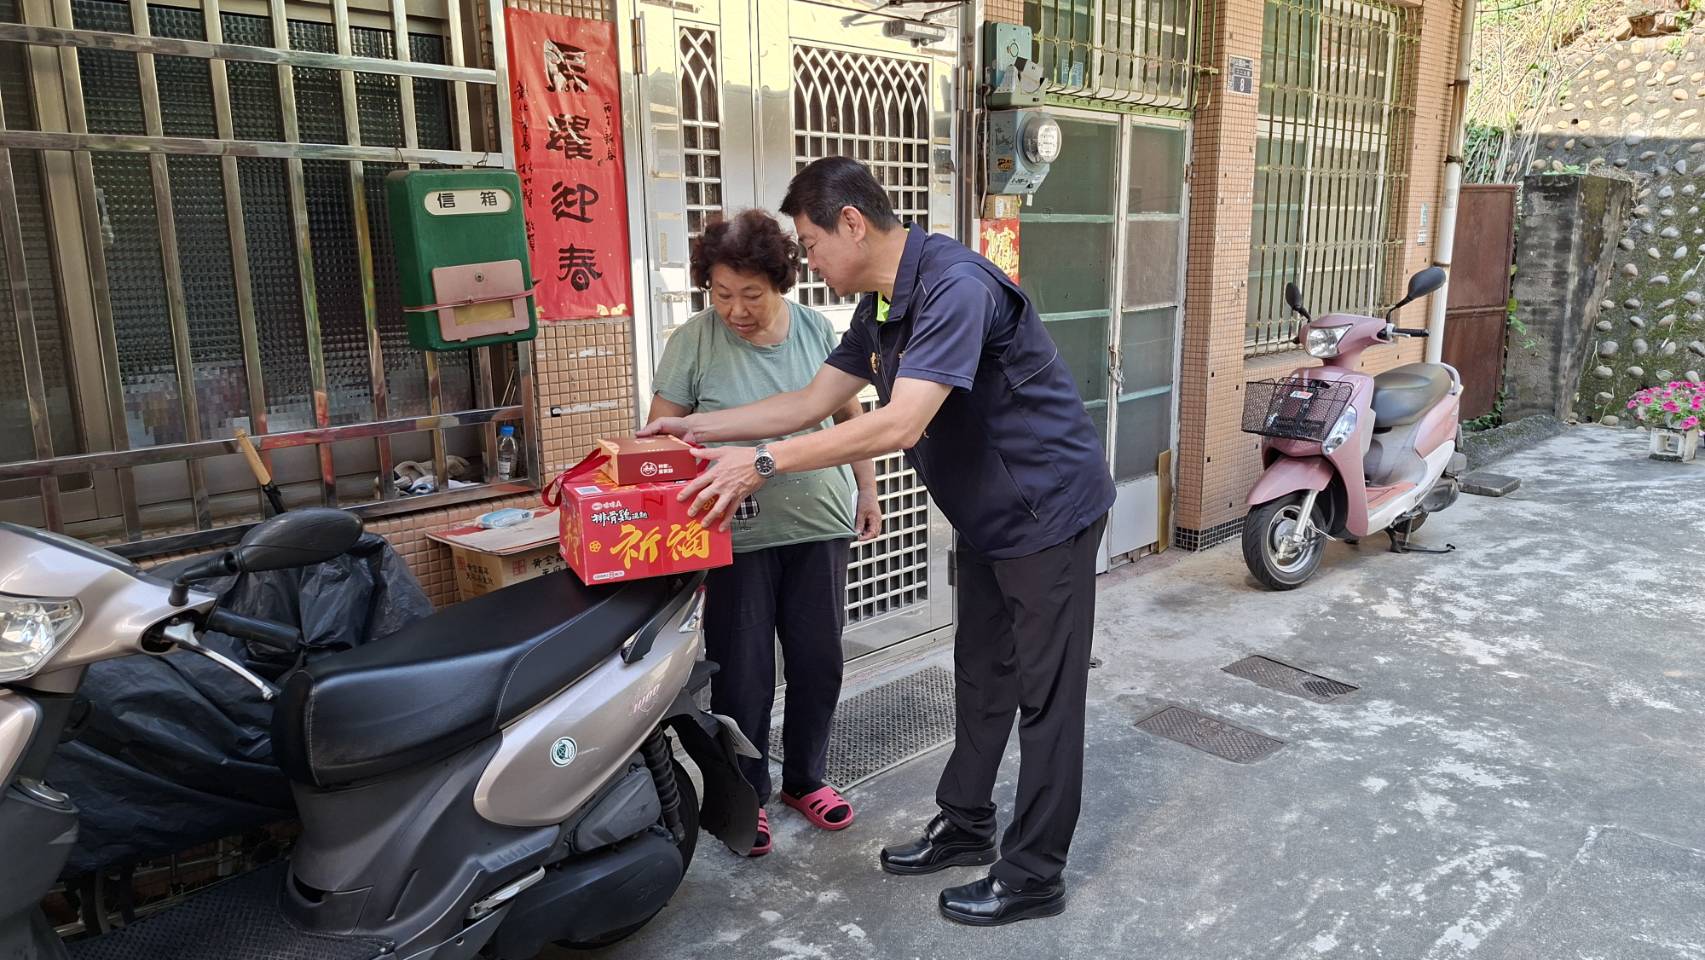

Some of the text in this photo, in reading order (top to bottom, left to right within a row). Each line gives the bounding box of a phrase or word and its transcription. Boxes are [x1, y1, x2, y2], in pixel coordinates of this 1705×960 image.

[1239, 78, 1245, 92] 8
[543, 39, 603, 291] 馬躍迎春
[437, 191, 499, 209] 信箱
[610, 520, 711, 570] 祈福
